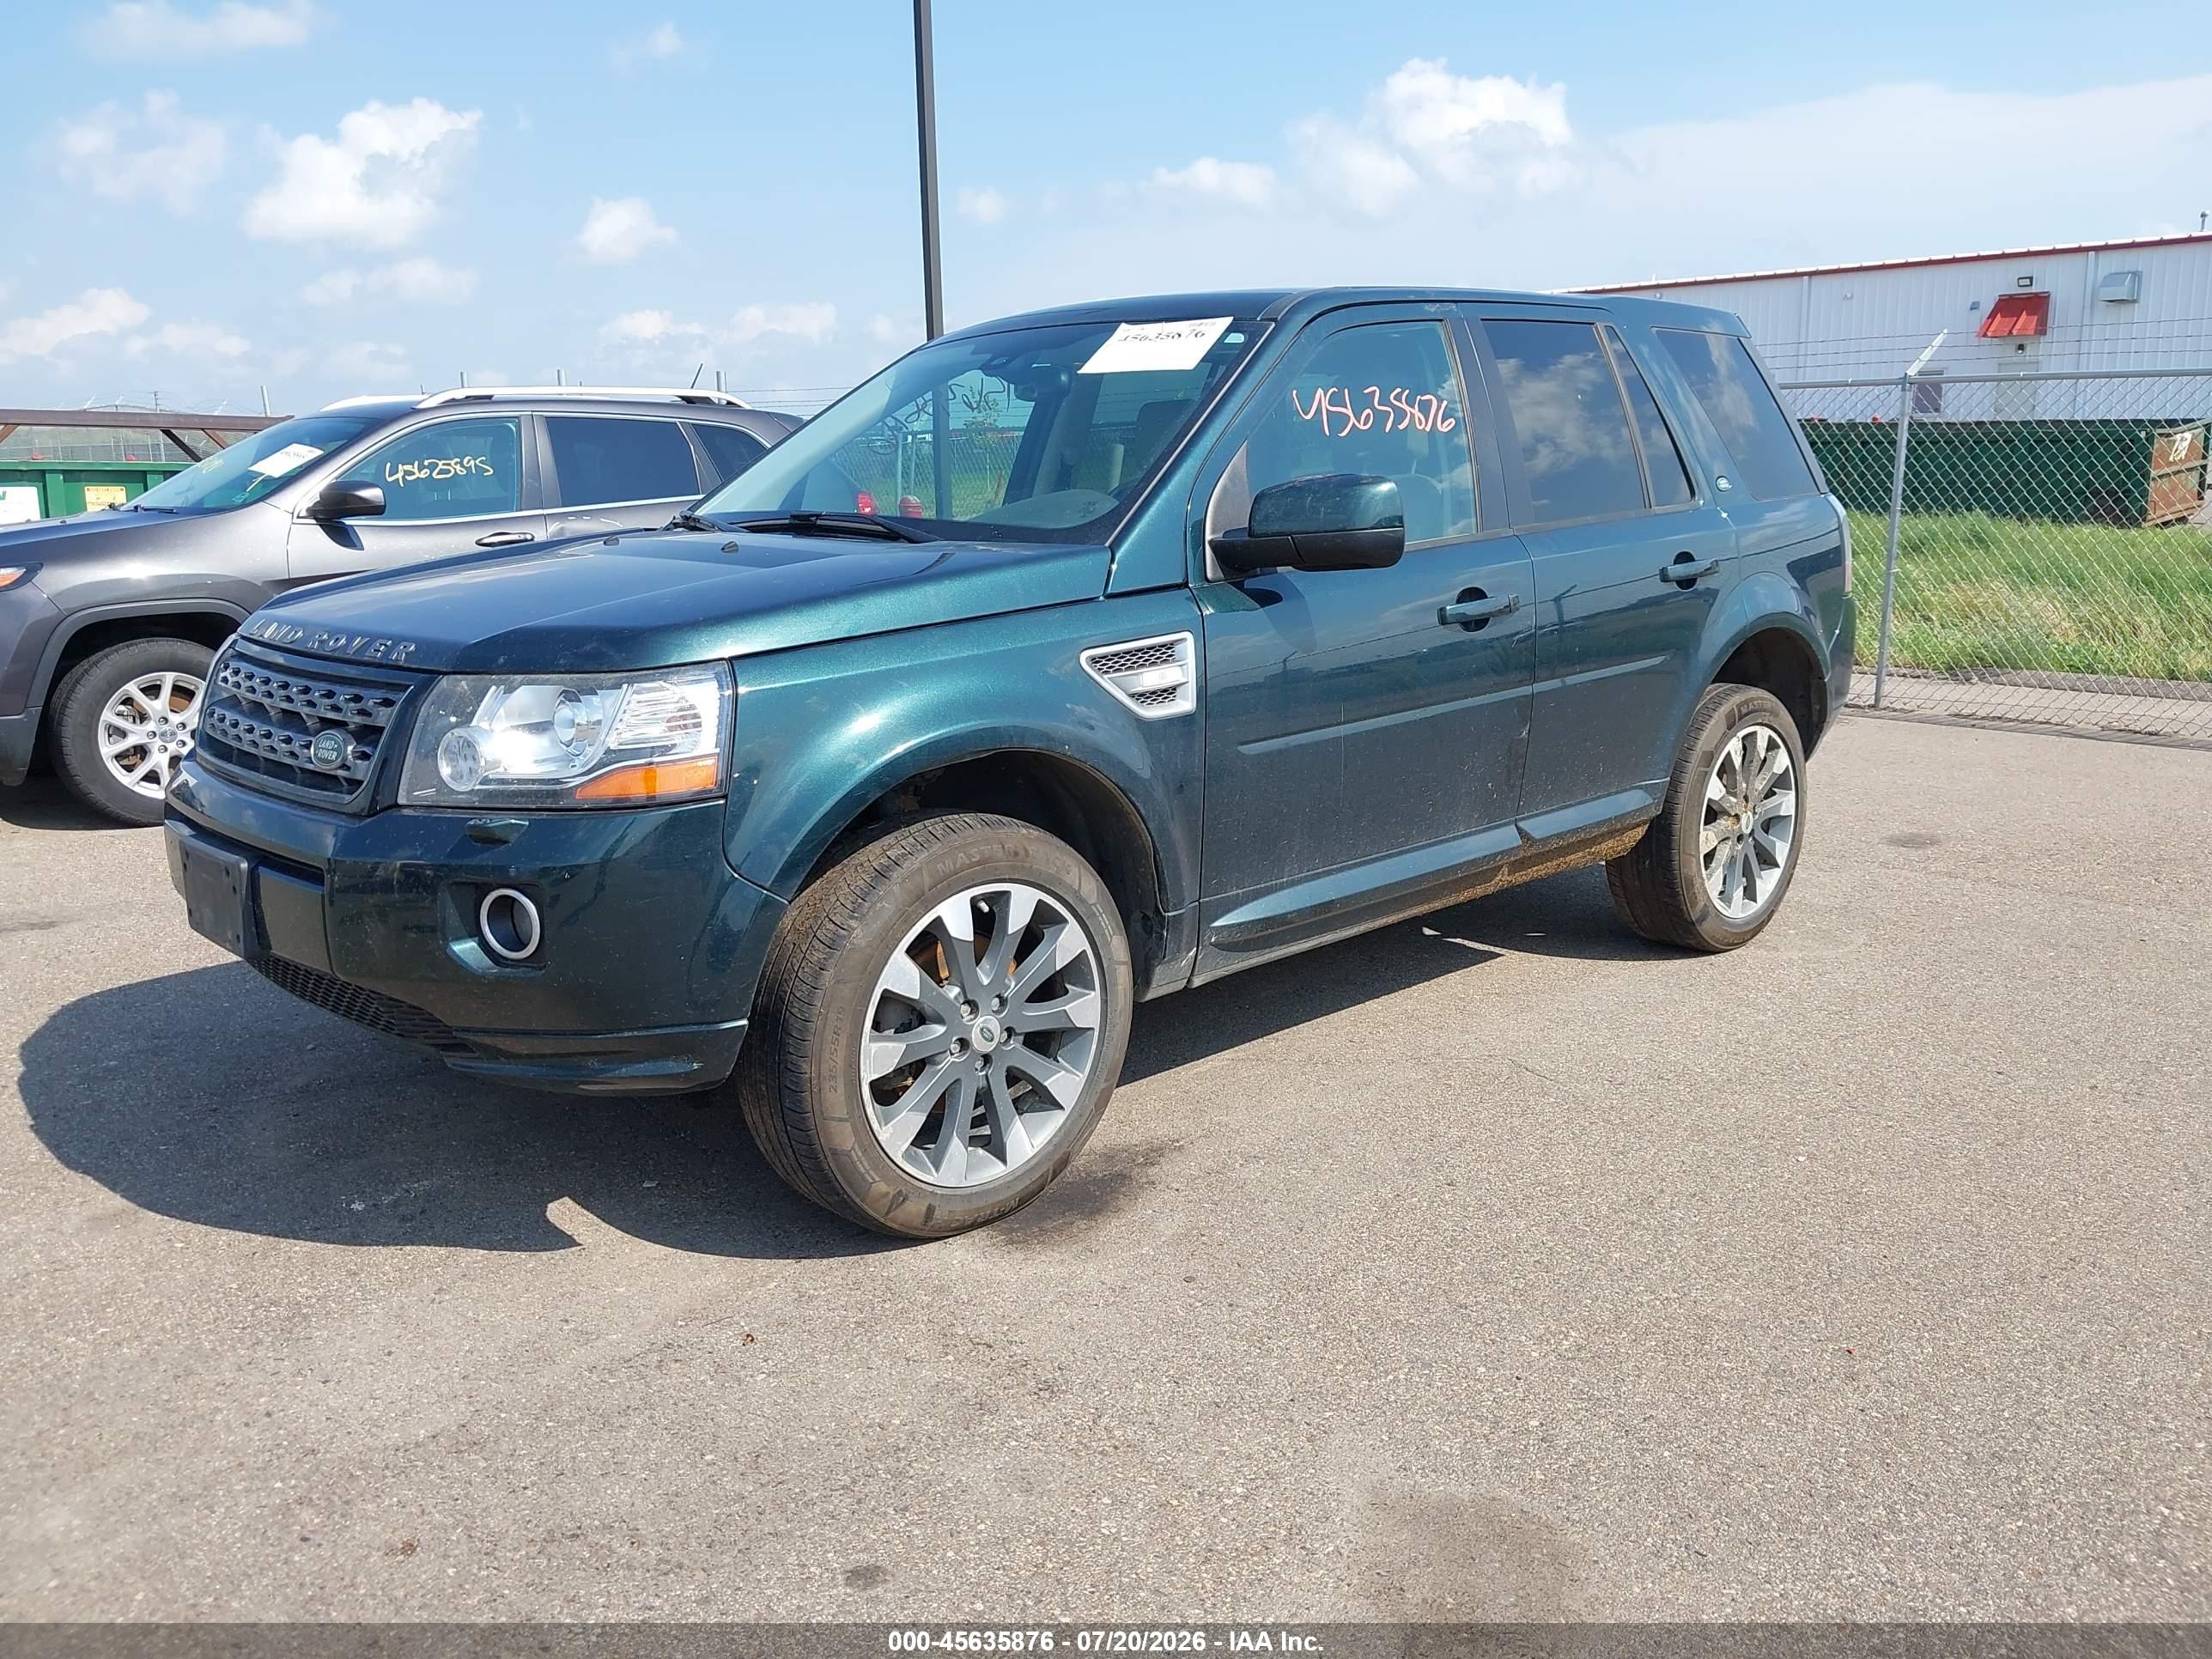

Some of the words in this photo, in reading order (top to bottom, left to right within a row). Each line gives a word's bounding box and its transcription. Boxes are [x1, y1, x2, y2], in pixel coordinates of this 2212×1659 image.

[1291, 386, 1456, 437] 45635876
[385, 455, 495, 488] 45625895
[249, 617, 303, 644] LAND
[307, 631, 416, 664] ROVER
[317, 748, 337, 762] ROVER
[318, 738, 335, 750] LAND
